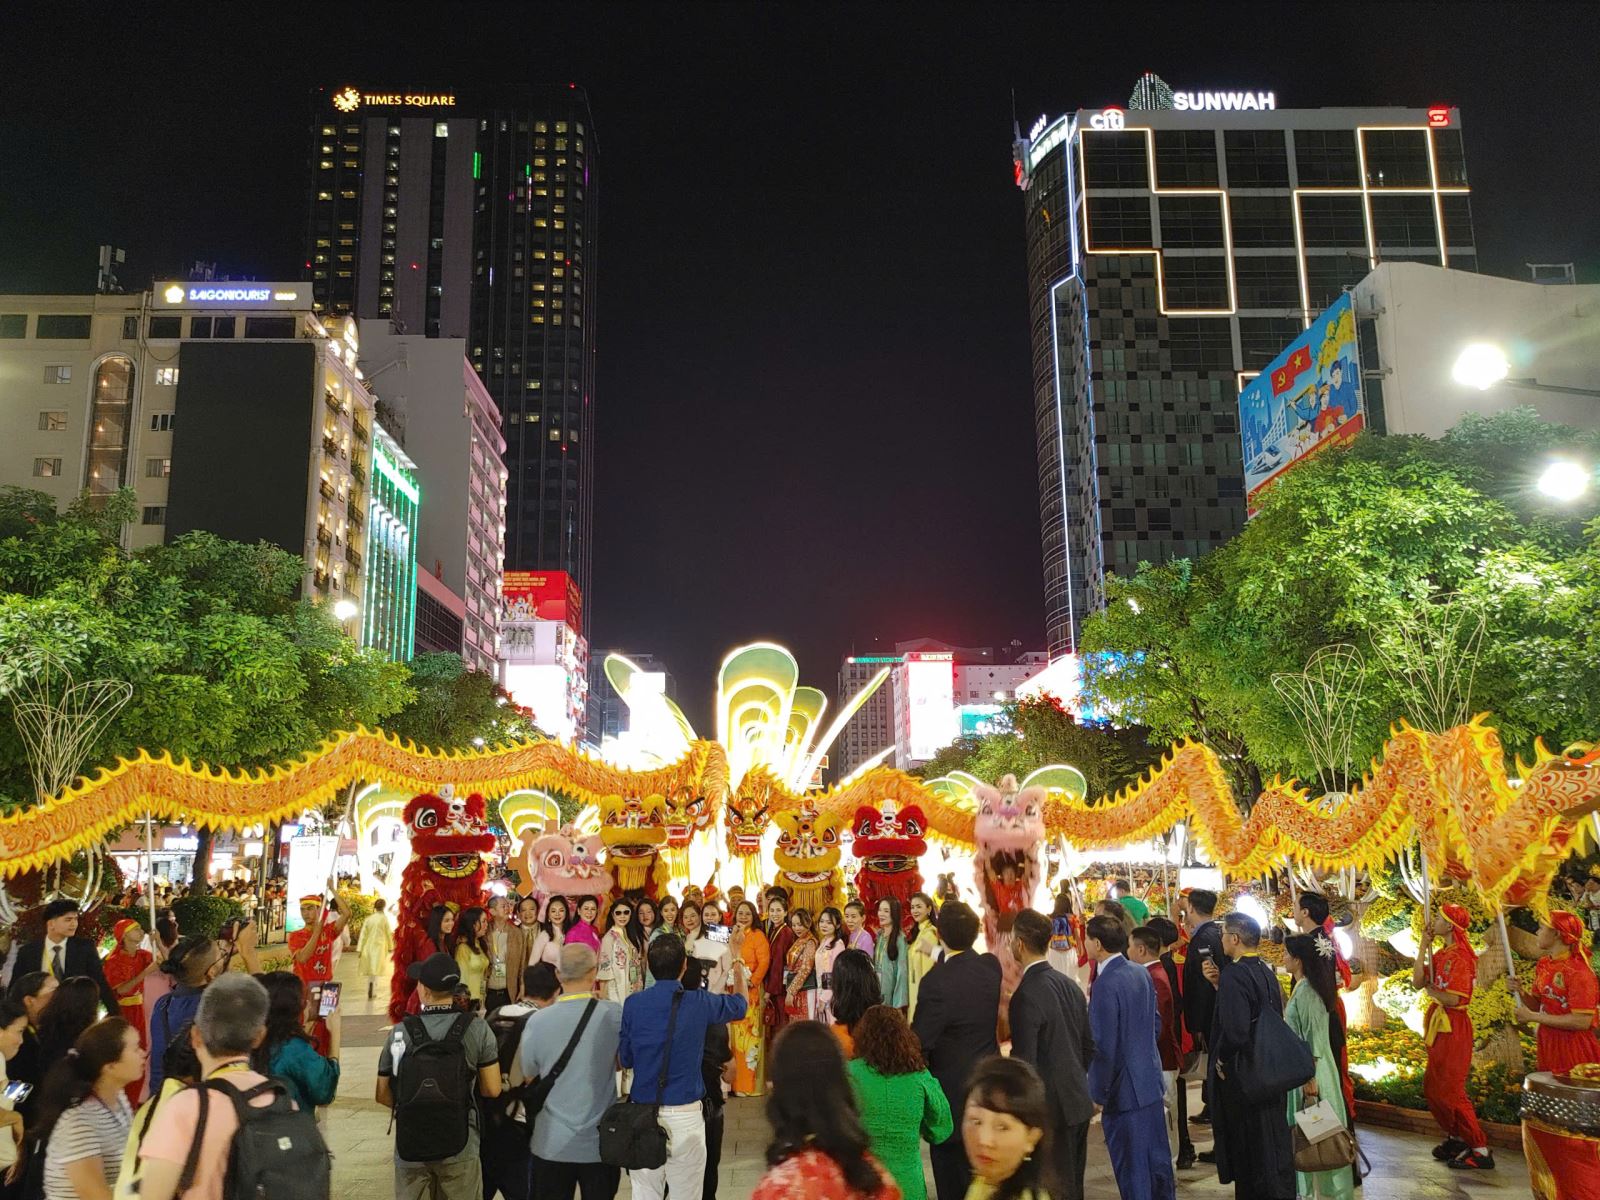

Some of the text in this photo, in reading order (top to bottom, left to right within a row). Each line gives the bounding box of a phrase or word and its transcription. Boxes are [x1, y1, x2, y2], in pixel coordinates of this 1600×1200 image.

[364, 95, 456, 107] TIMES SQUARE
[1173, 91, 1276, 111] SUNWAH
[1089, 109, 1125, 129] citi
[189, 288, 271, 301] SAIGONTOURIST
